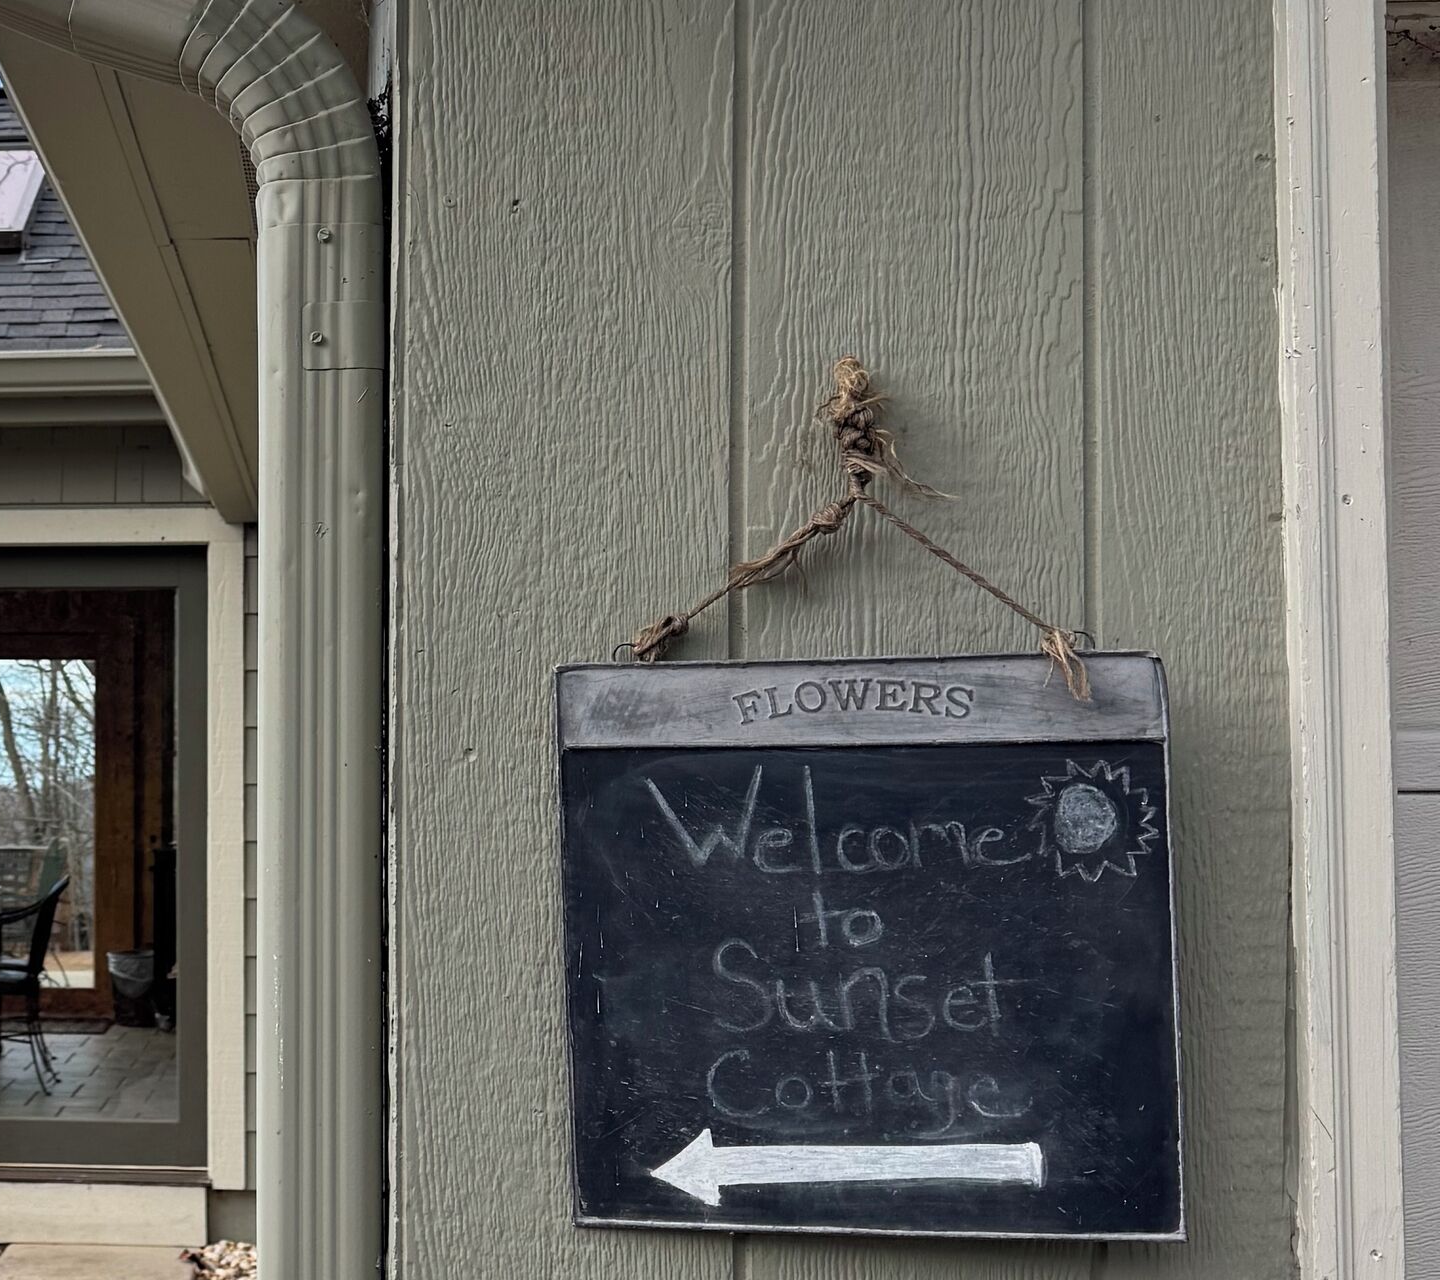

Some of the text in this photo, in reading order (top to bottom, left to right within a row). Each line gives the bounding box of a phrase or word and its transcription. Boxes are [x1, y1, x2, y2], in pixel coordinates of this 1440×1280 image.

[733, 678, 976, 725] FLOWERS
[644, 764, 1031, 874] Welcome
[798, 890, 884, 948] to
[713, 938, 1030, 1043] Sunset
[707, 1049, 1034, 1139] Cottage
